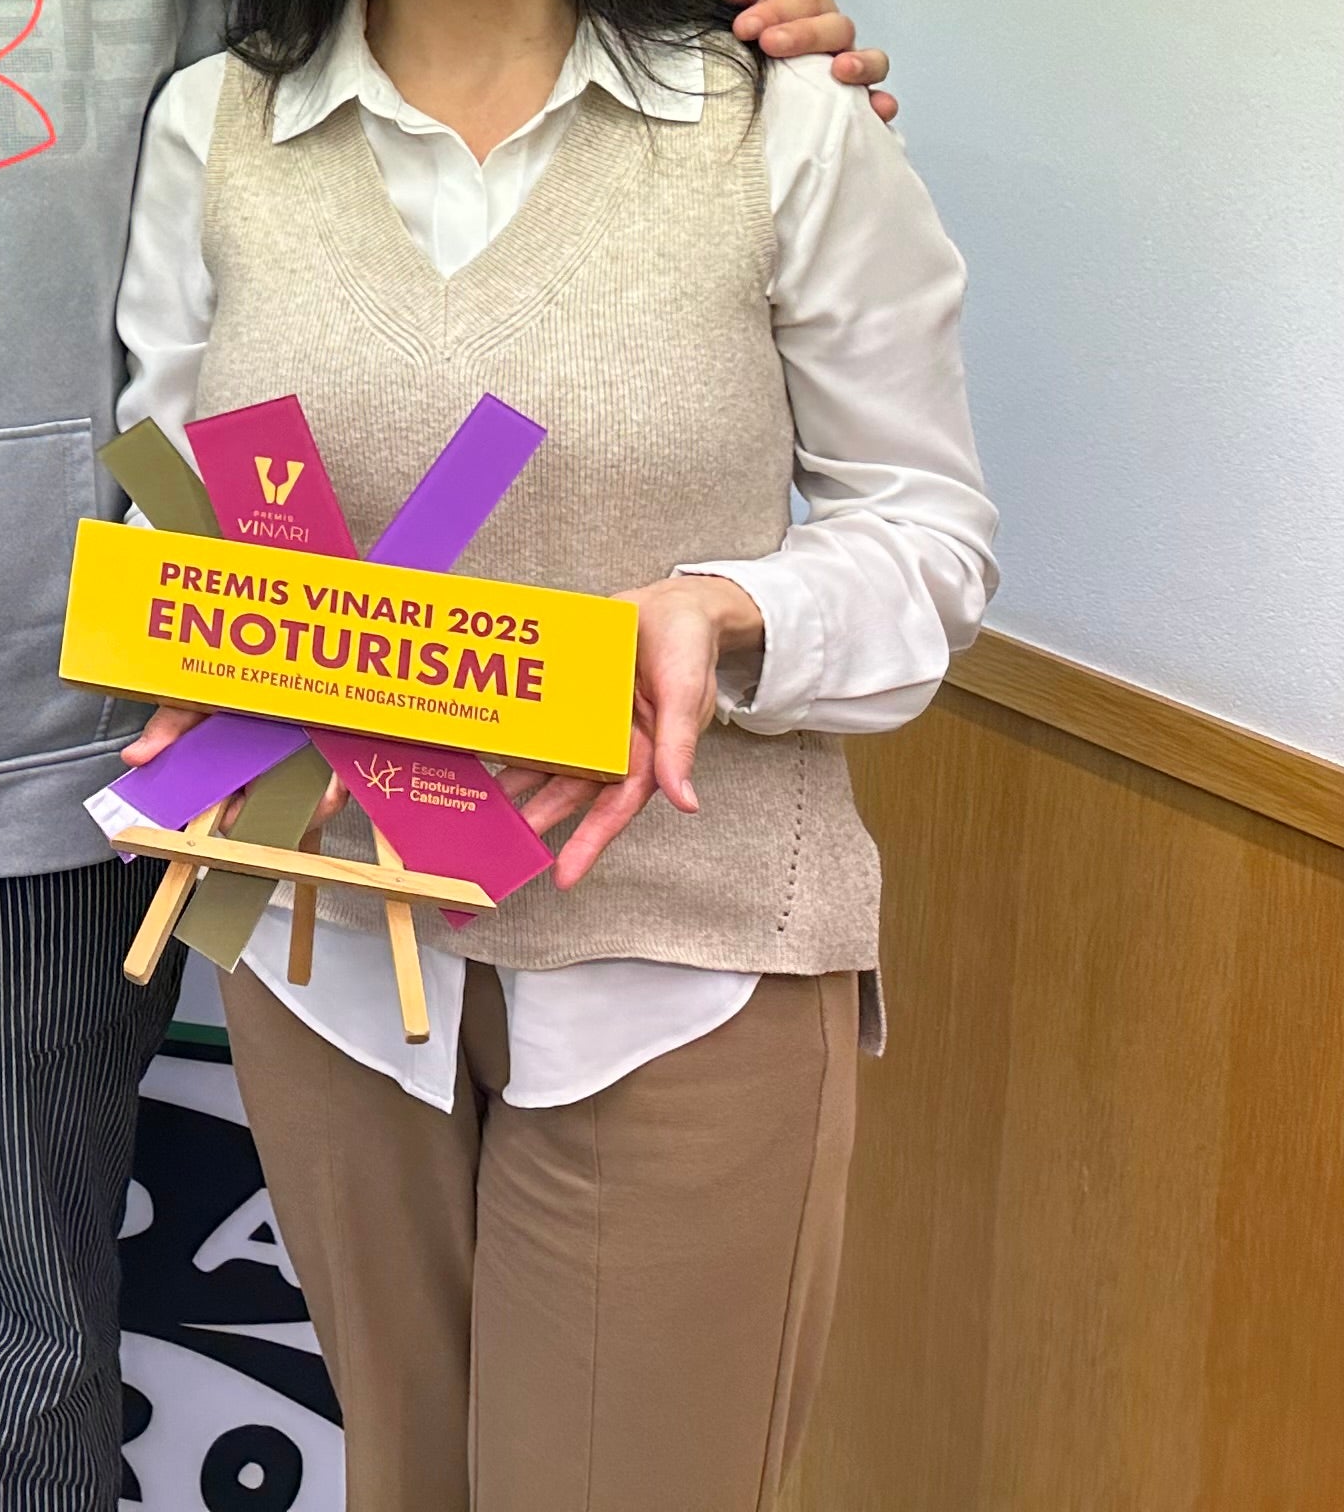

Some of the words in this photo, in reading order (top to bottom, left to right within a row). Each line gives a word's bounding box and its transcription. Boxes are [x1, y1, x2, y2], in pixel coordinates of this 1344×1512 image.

[253, 510, 294, 523] PREMIS
[237, 518, 309, 543] VINARI
[159, 561, 290, 606] PREMIS
[303, 584, 434, 629] VINARI
[447, 607, 540, 645] 2025
[148, 598, 545, 702] ENOTURISME
[181, 656, 236, 680] MILLOR
[241, 666, 340, 698] EXPERIÈNCIA
[345, 684, 501, 724] ENOGASTRONÒMICA
[412, 762, 456, 780] Escola
[411, 777, 488, 800] Enoturisme
[410, 790, 476, 812] Catalunya
